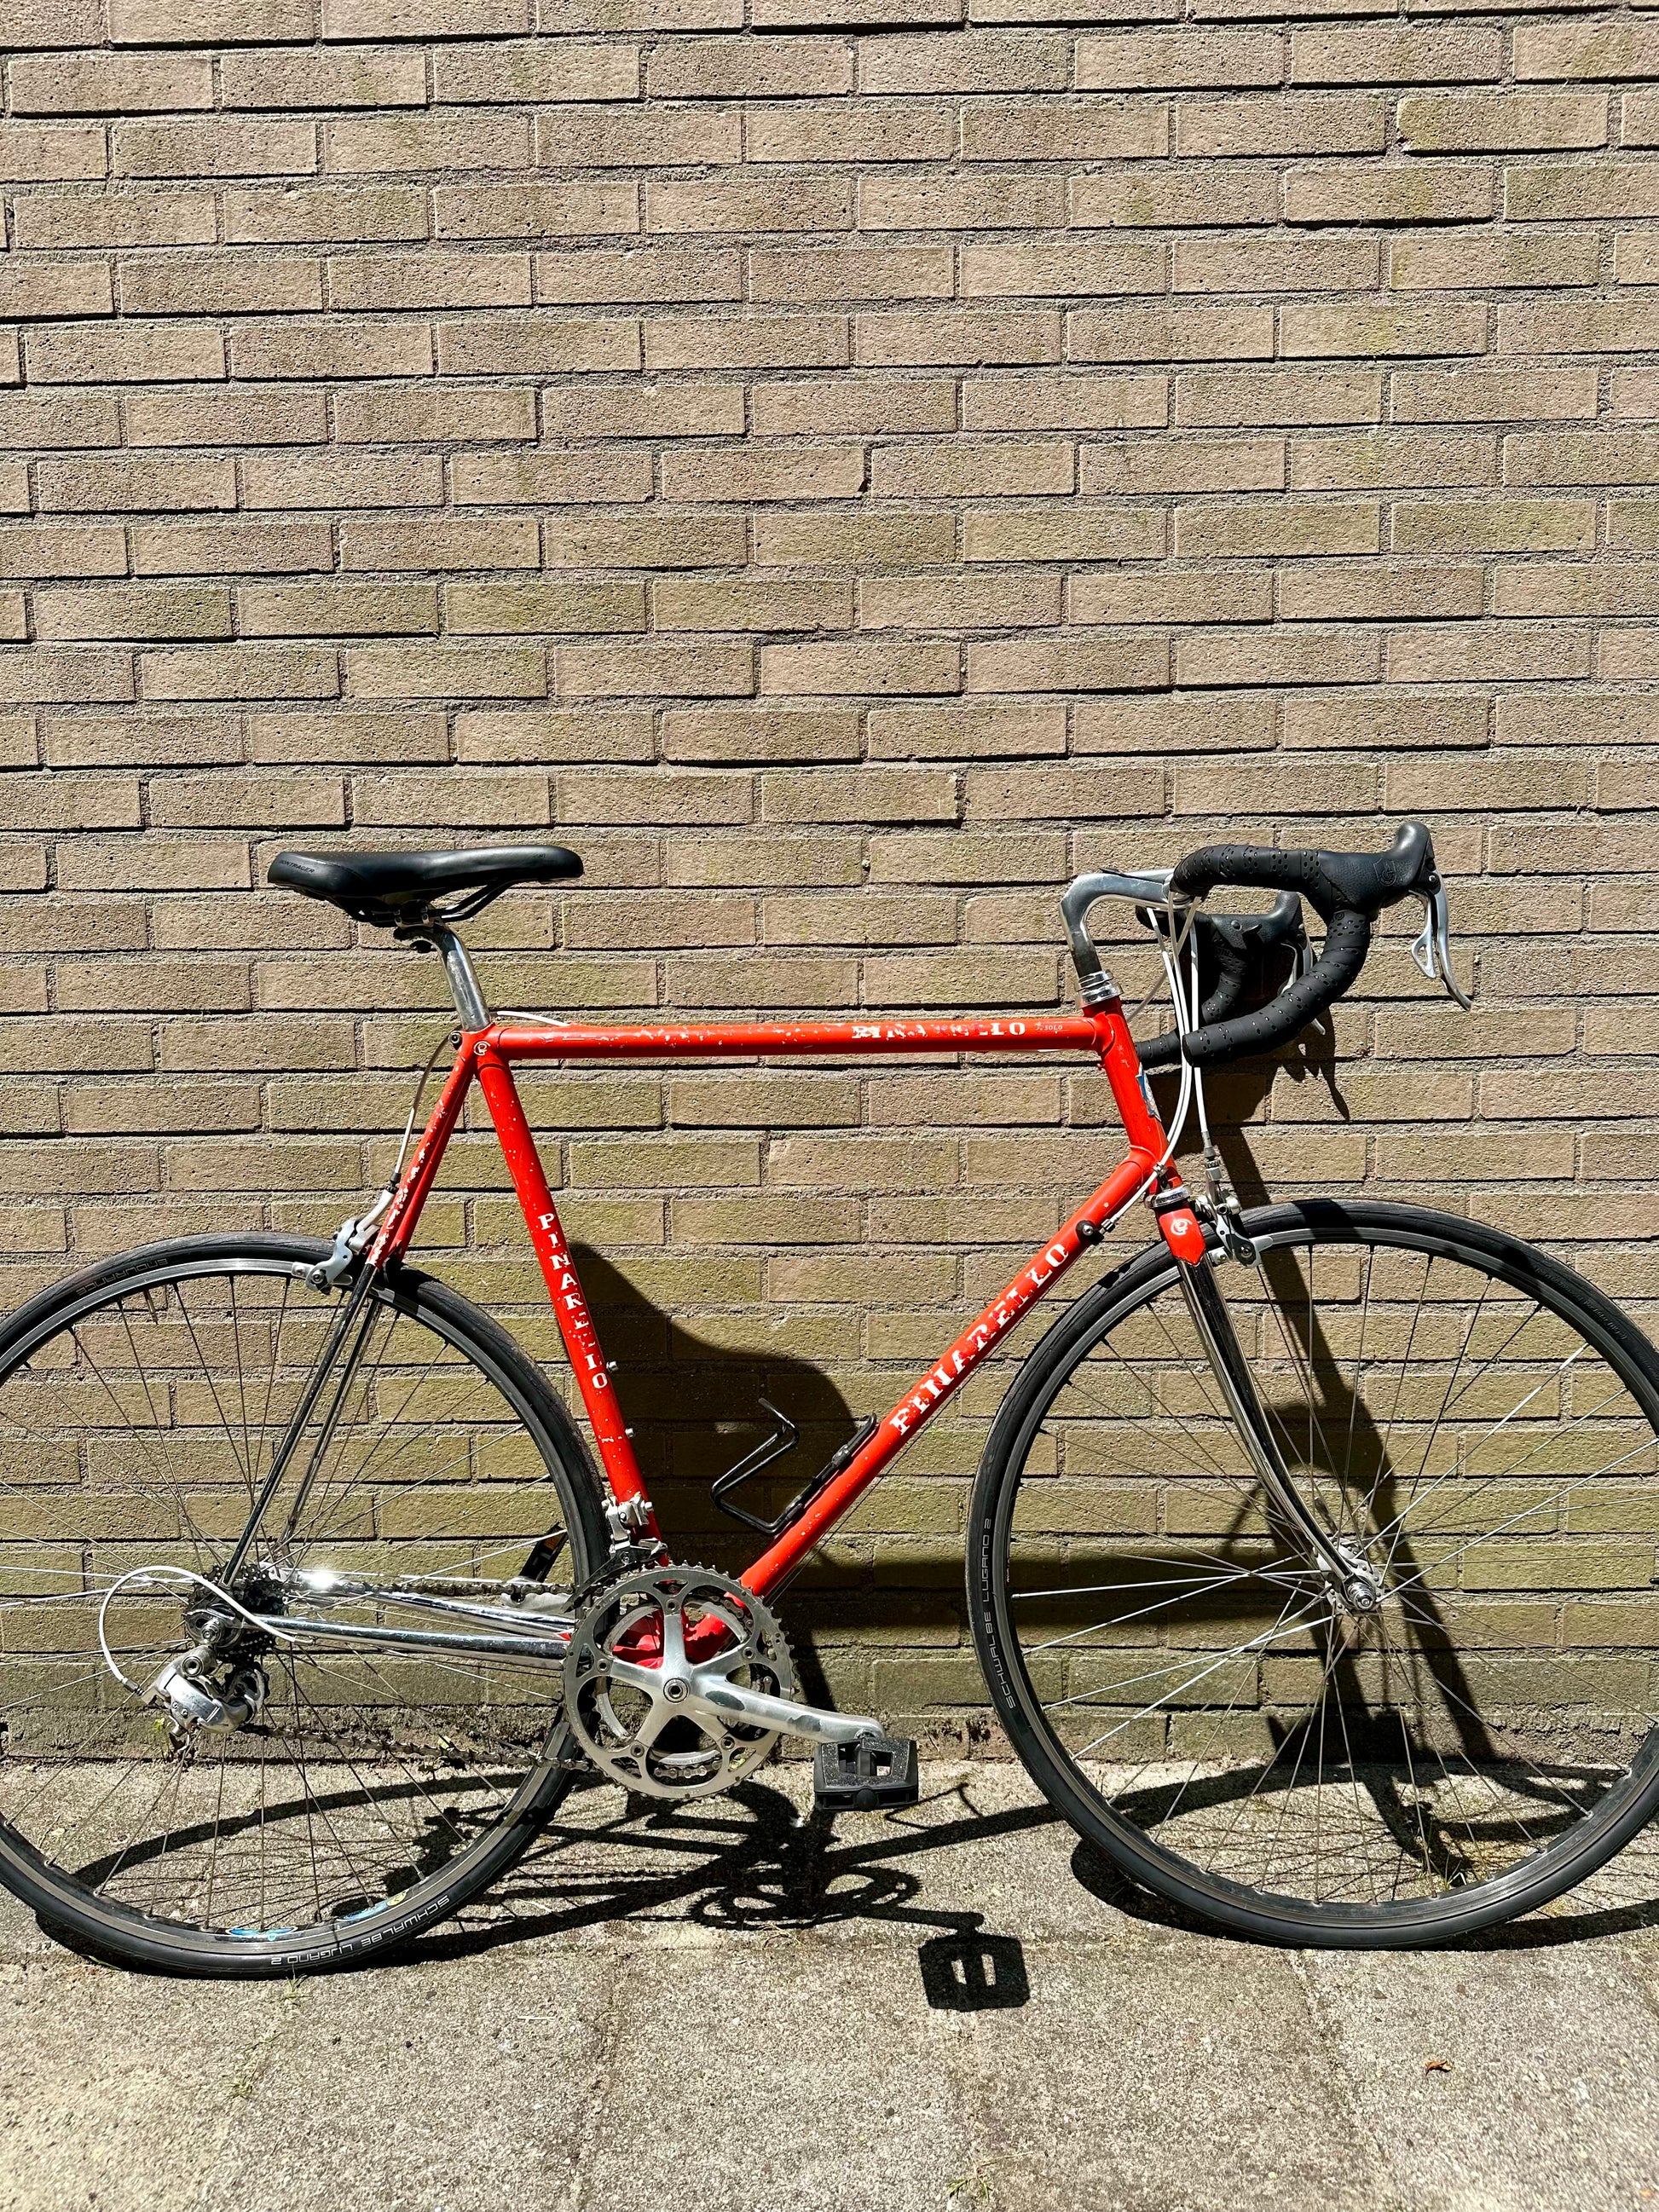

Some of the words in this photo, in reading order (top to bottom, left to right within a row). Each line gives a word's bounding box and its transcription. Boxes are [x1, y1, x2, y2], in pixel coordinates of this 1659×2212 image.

[75, 1257, 169, 1297] ENDURANCE
[984, 1517, 991, 1529] 2
[982, 1534, 991, 1603] LUGANO
[983, 1611, 1016, 1709] SCHWALBE
[361, 1894, 450, 1948] SCHWALBE
[270, 1957, 282, 1966] 2
[287, 1943, 354, 1965] LUGANO
